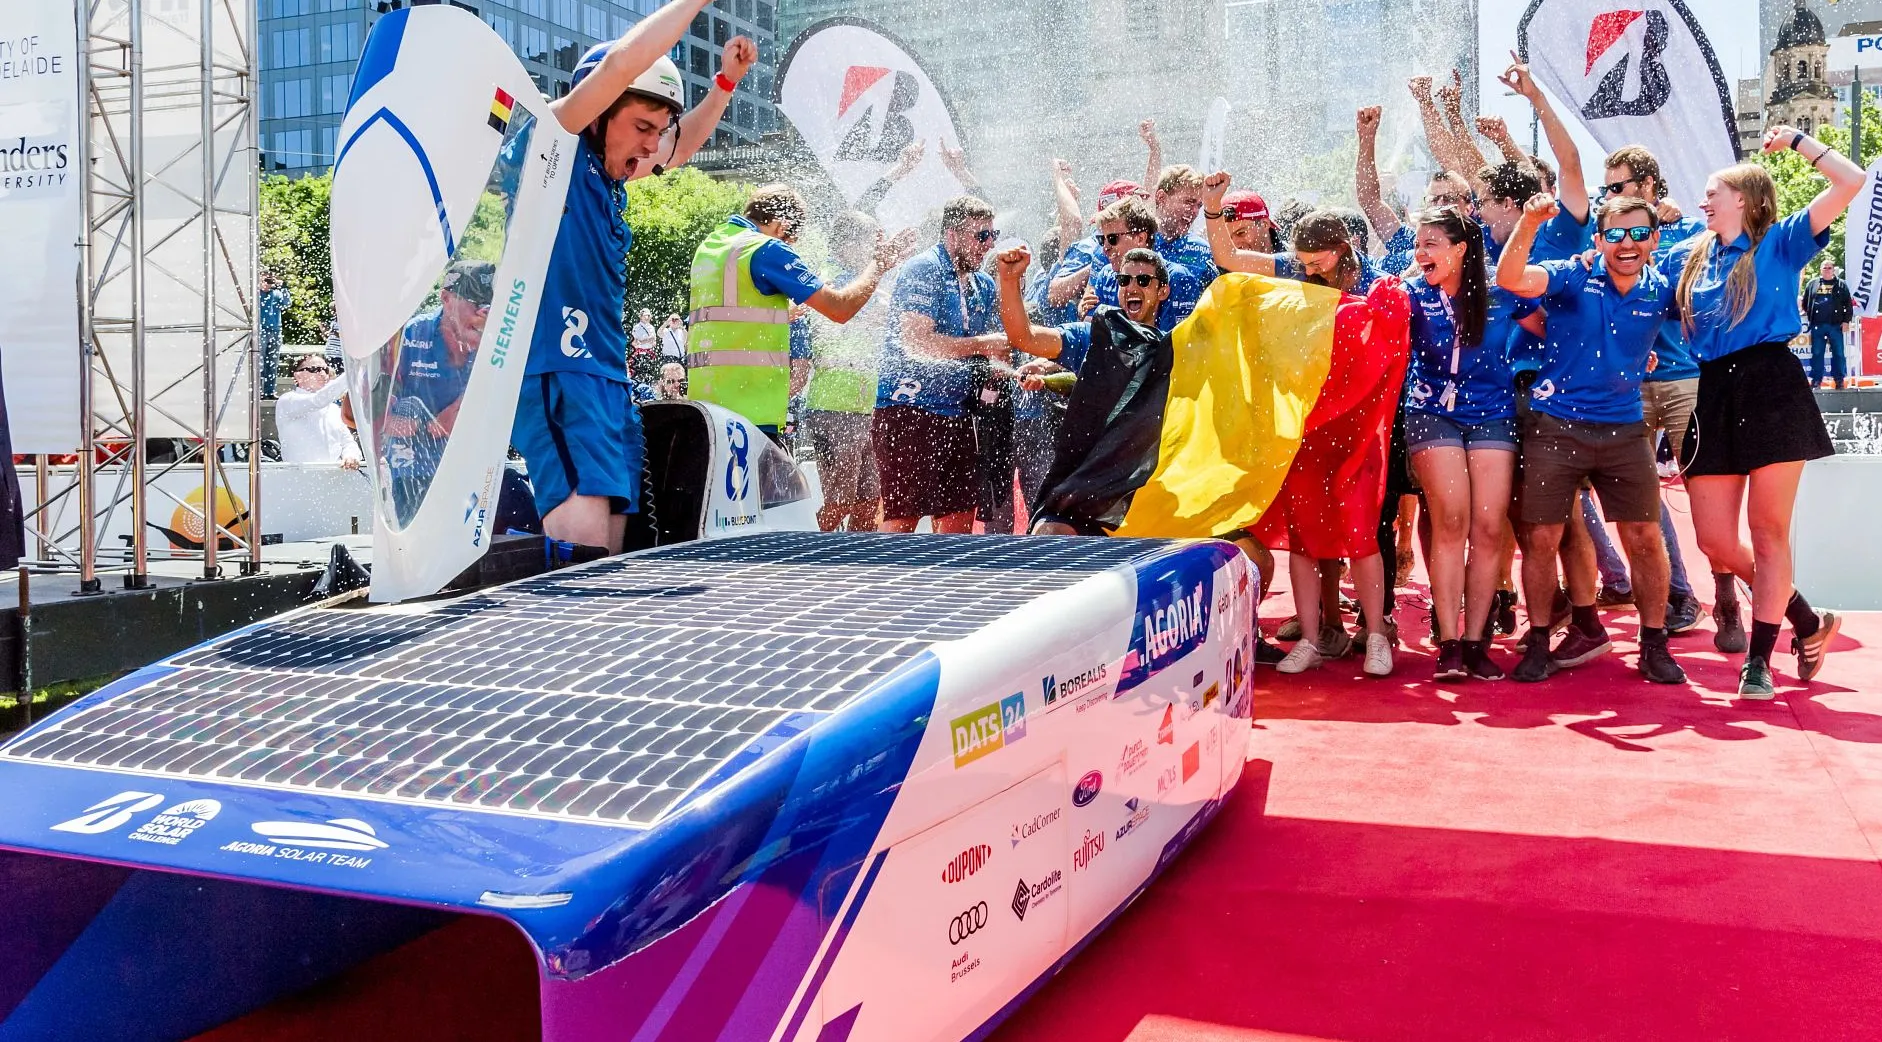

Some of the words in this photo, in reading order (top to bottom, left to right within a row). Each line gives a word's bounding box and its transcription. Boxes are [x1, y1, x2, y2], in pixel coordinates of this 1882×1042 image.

[21, 35, 39, 55] OF
[0, 56, 62, 79] ELAIDE
[552, 153, 560, 170] OPEN
[4, 173, 66, 189] ERSITY
[549, 170, 556, 179] TO
[490, 278, 526, 369] SIEMENS
[473, 465, 495, 547] AZURSPACE
[1059, 663, 1107, 699] BOREALIS
[955, 712, 1000, 758] DATS
[1005, 702, 1024, 735] 24
[1077, 775, 1099, 802] Ford
[136, 822, 195, 839] SOLAR
[151, 814, 207, 830] WORLD
[1021, 807, 1062, 840] CadCorner
[128, 832, 183, 845] CHALLENGE
[274, 847, 329, 864] SOLAR
[326, 853, 373, 869] TEAM
[948, 843, 987, 885] DUPONT
[1073, 830, 1105, 873] FUJITSU
[1031, 869, 1062, 899] Cardolite
[951, 951, 970, 971] Audi
[951, 957, 981, 984] Brussels
